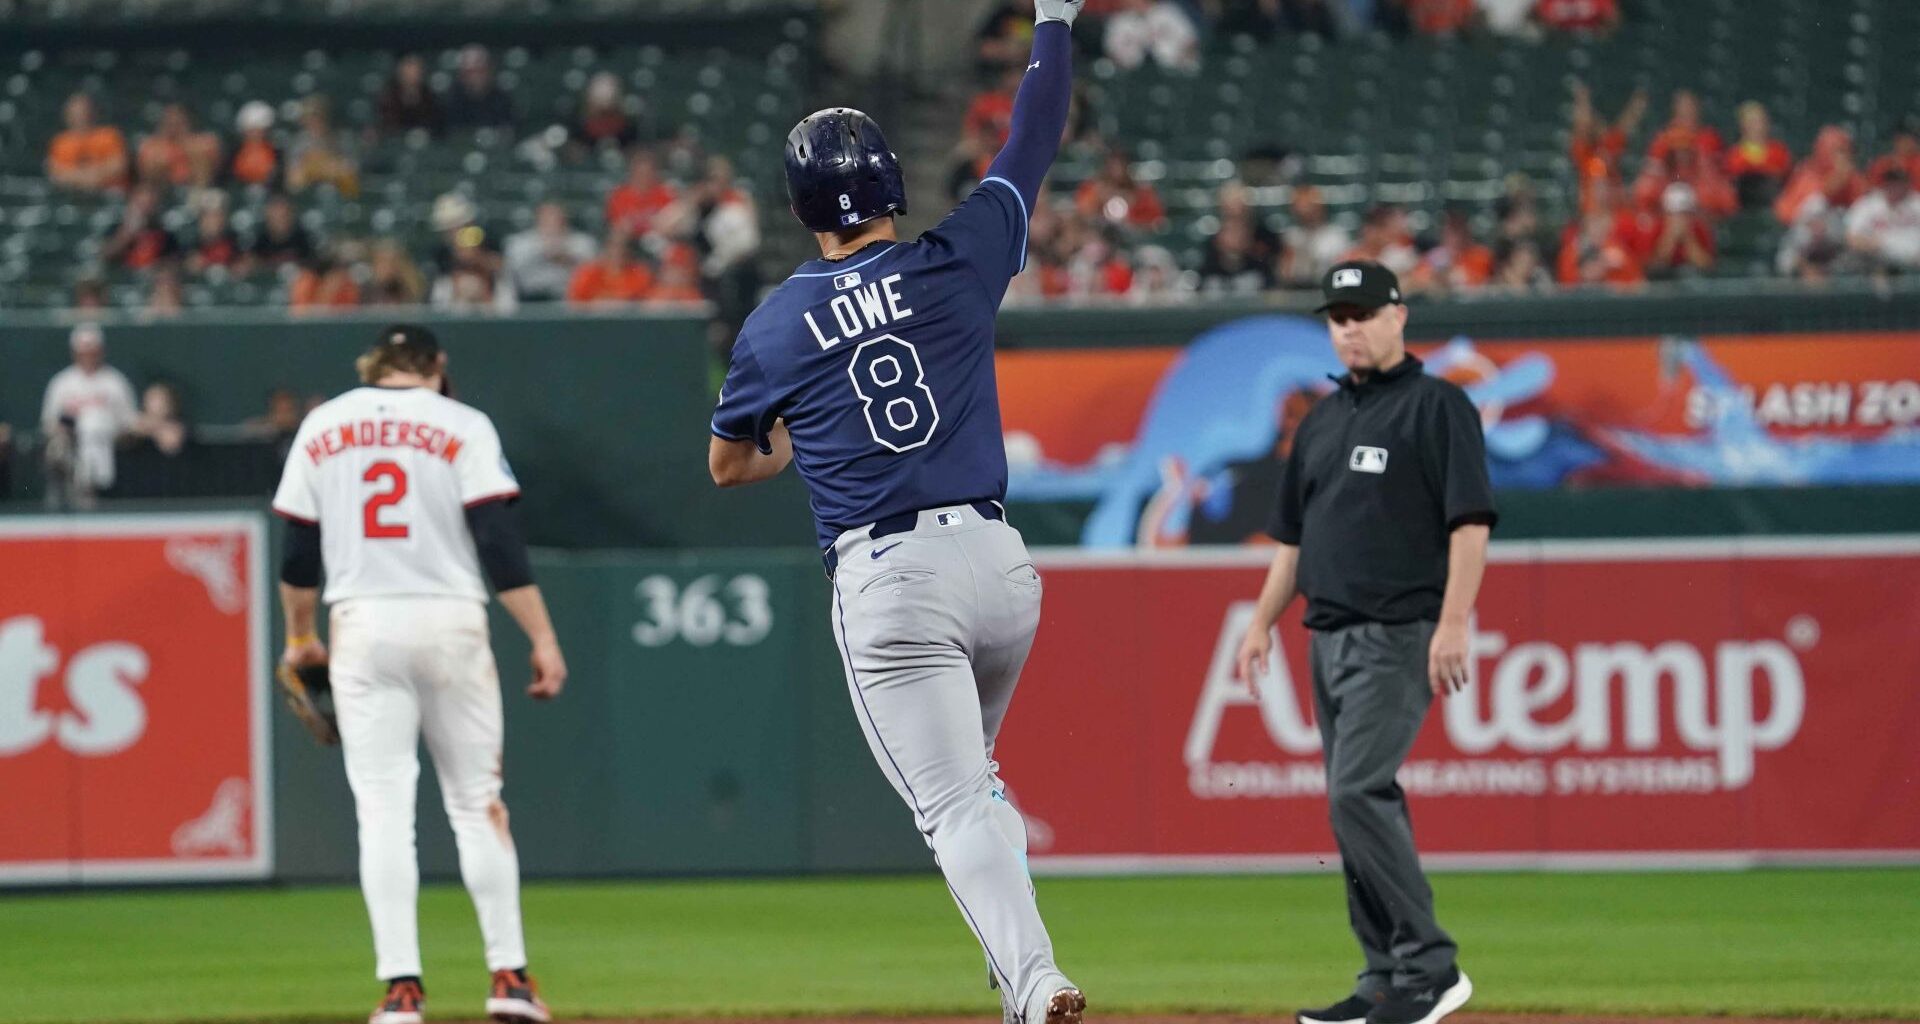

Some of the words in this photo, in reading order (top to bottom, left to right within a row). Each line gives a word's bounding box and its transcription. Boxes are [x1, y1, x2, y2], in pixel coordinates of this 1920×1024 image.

[839, 194, 851, 210] 8
[804, 273, 913, 351] LOWE
[848, 333, 940, 453] 8
[306, 421, 464, 466] HENDERSON
[364, 460, 409, 539] 2
[631, 574, 774, 646] 363
[1184, 600, 1806, 789] Atemp
[1188, 761, 1326, 798] COOLIN
[1552, 757, 1715, 795] SYSTEMS
